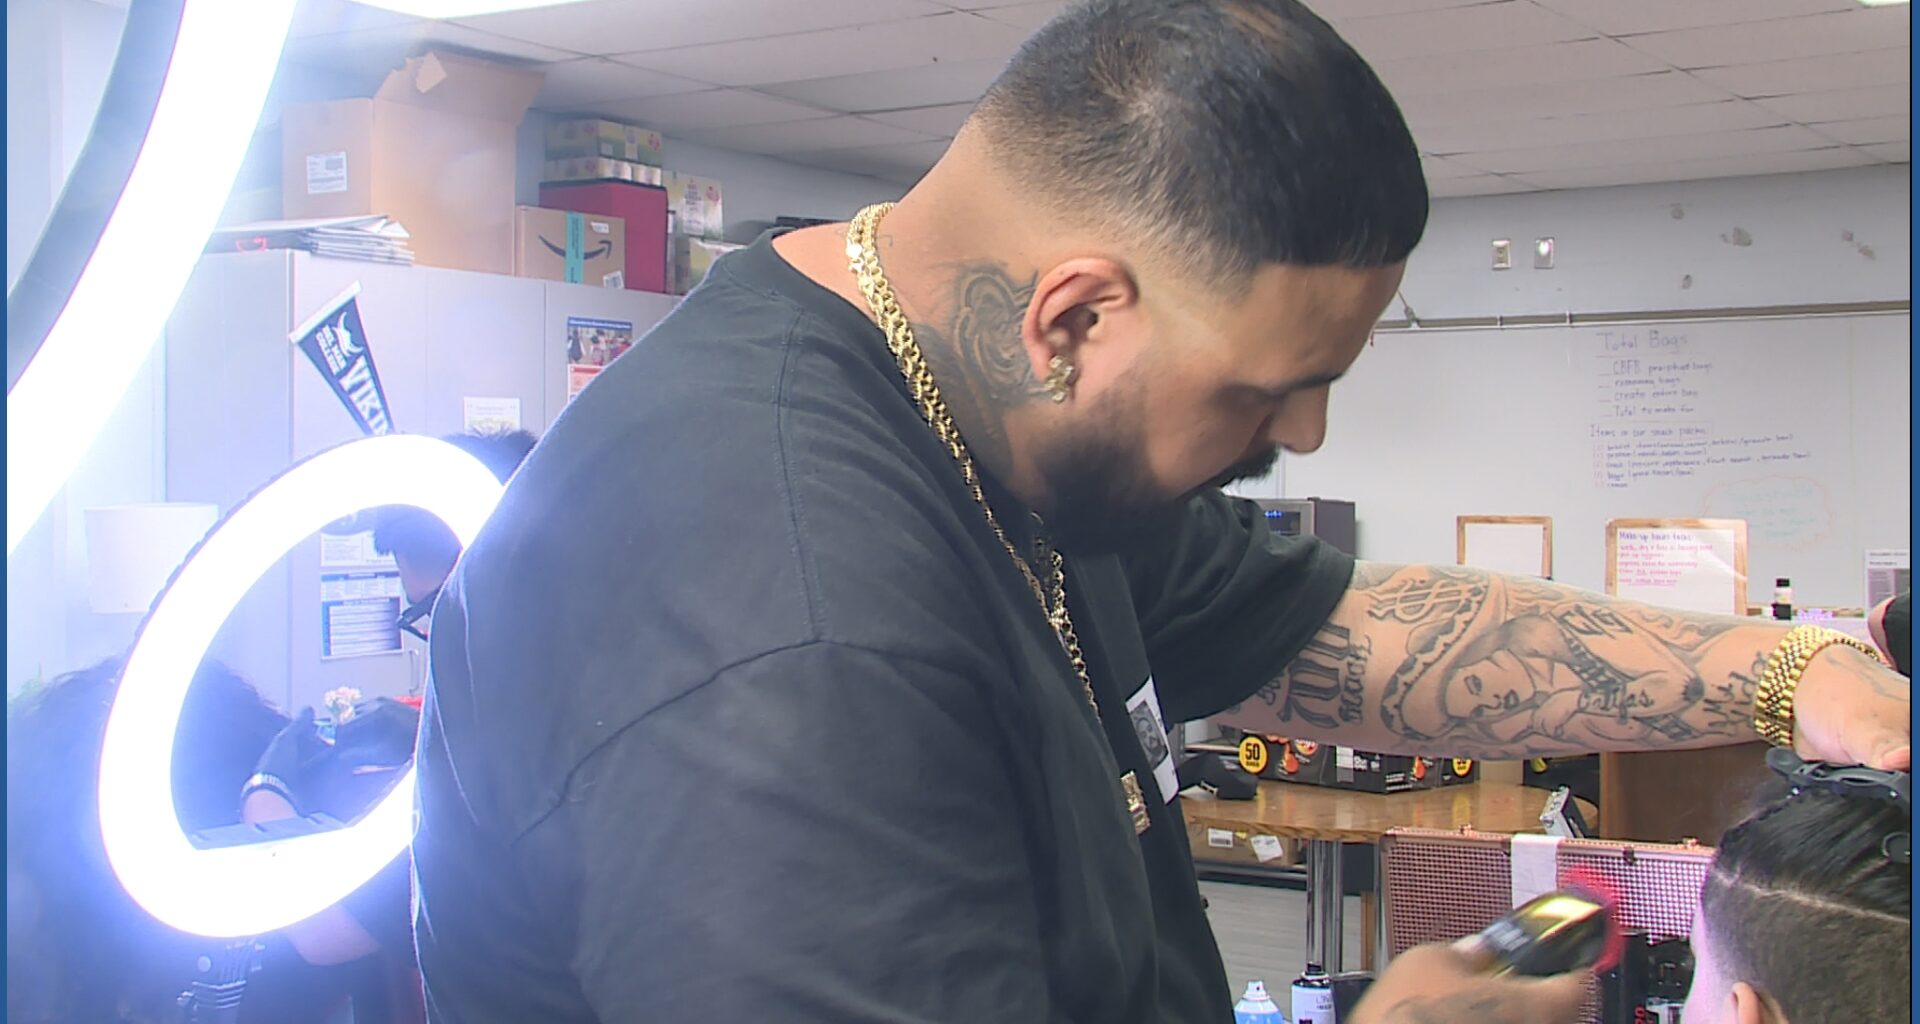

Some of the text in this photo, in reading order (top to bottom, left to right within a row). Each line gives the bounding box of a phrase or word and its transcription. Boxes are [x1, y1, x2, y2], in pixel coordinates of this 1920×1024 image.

[1596, 329, 1689, 353] Total Bags
[331, 344, 347, 370] MAR
[1245, 742, 1260, 760] 50
